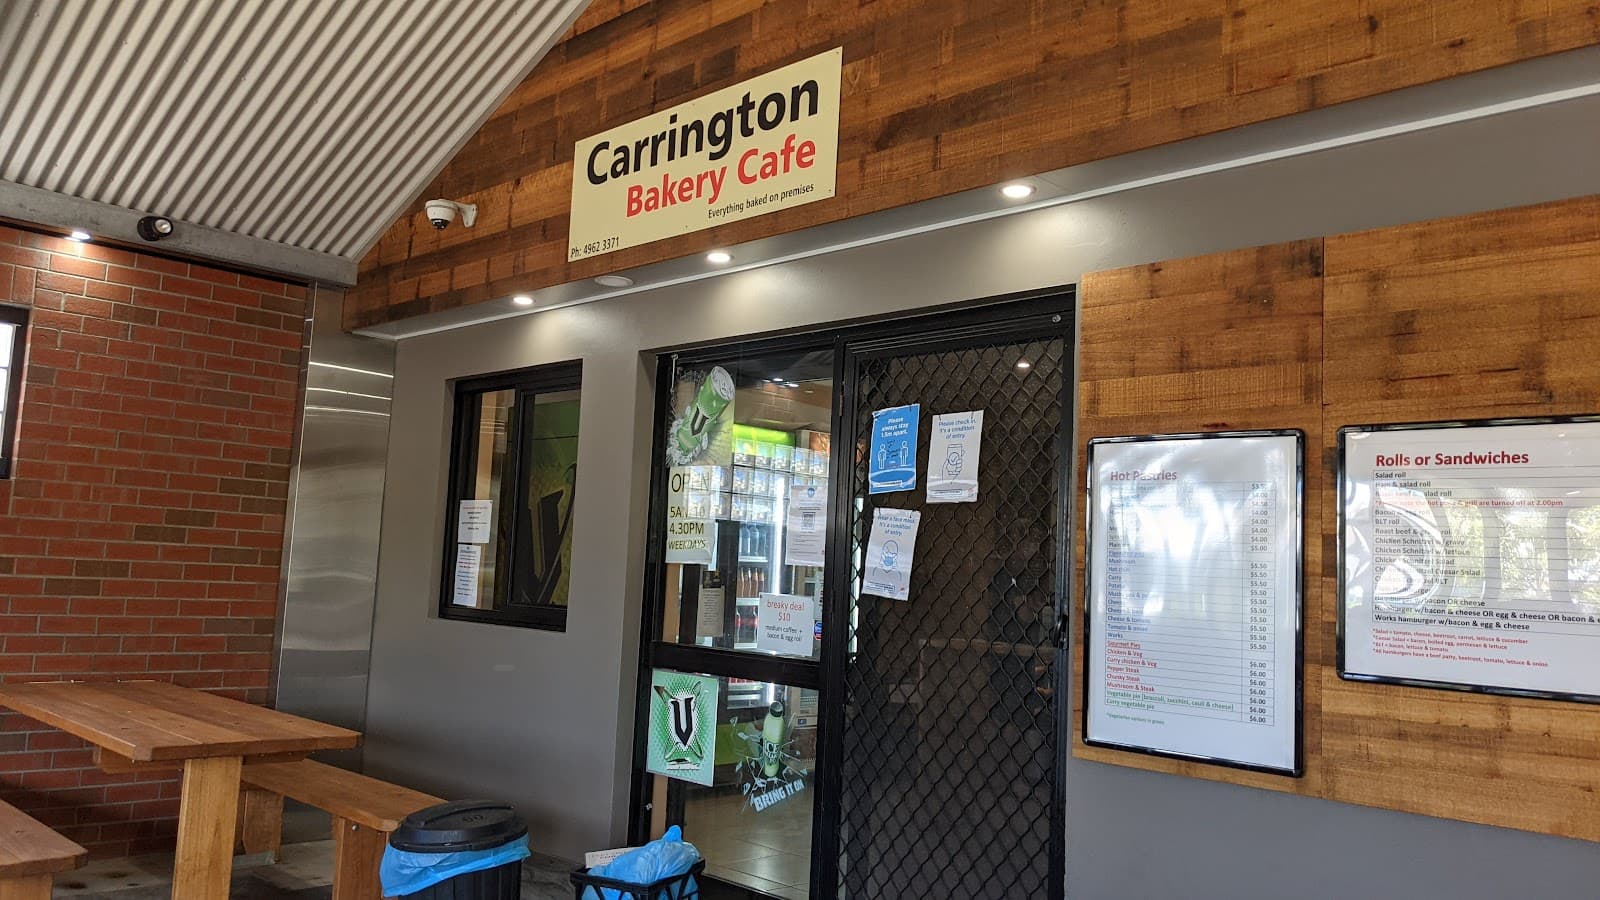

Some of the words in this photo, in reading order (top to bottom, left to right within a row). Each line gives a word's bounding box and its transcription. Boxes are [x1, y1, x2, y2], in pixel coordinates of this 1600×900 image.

[586, 79, 819, 186] Carrington
[626, 166, 728, 218] Bakery
[737, 133, 816, 185] Cafe
[708, 202, 744, 219] Everything
[746, 192, 768, 209] baked
[769, 193, 779, 203] on
[780, 182, 814, 203] premises
[571, 247, 582, 259] Ph:
[583, 241, 601, 256] 4962
[602, 236, 620, 251] 3371
[1375, 453, 1410, 467] Rolls
[1414, 454, 1431, 467] or
[1434, 450, 1530, 466] Sandwiches
[1110, 471, 1131, 481] Hot
[1133, 469, 1177, 481] Pastries
[1536, 499, 1563, 508] 2.00pm
[669, 522, 705, 535] 4.30PM
[668, 539, 706, 550] WEEKDAYS
[766, 600, 789, 611] breaky
[789, 601, 805, 611] deal
[1459, 599, 1486, 608] cheese
[778, 611, 791, 622] $10
[1414, 606, 1446, 615] w/bacon
[1455, 608, 1481, 616] cheese
[1495, 611, 1509, 620] egg
[1519, 612, 1546, 620] cheese
[1547, 613, 1560, 621] OR
[1561, 614, 1586, 623] bacon
[1374, 614, 1397, 622] Works
[1398, 616, 1437, 625] hamburger
[1438, 618, 1471, 627] w/bacon
[1471, 619, 1478, 627] &
[1503, 621, 1530, 630] cheese
[782, 626, 797, 634] coffee
[1107, 640, 1130, 648] Gourmet
[1107, 648, 1127, 656] Chicken
[1106, 656, 1121, 664] Curry
[1121, 658, 1141, 666] chicken
[1106, 665, 1125, 673] Pepper
[1106, 673, 1125, 681] Chunky
[1106, 681, 1134, 690] Mushroom
[1106, 690, 1132, 699] Vegetable
[1132, 693, 1141, 701] pie
[1249, 697, 1266, 705] $6.00
[1106, 698, 1120, 706] Curry
[1120, 700, 1146, 709] vegetable
[1146, 703, 1155, 711] pie
[1249, 706, 1266, 714] $6.00
[671, 696, 694, 748] V
[1249, 715, 1266, 723] $6.00
[753, 786, 787, 813] BRING
[785, 782, 795, 796] IT
[793, 778, 805, 792] ON
